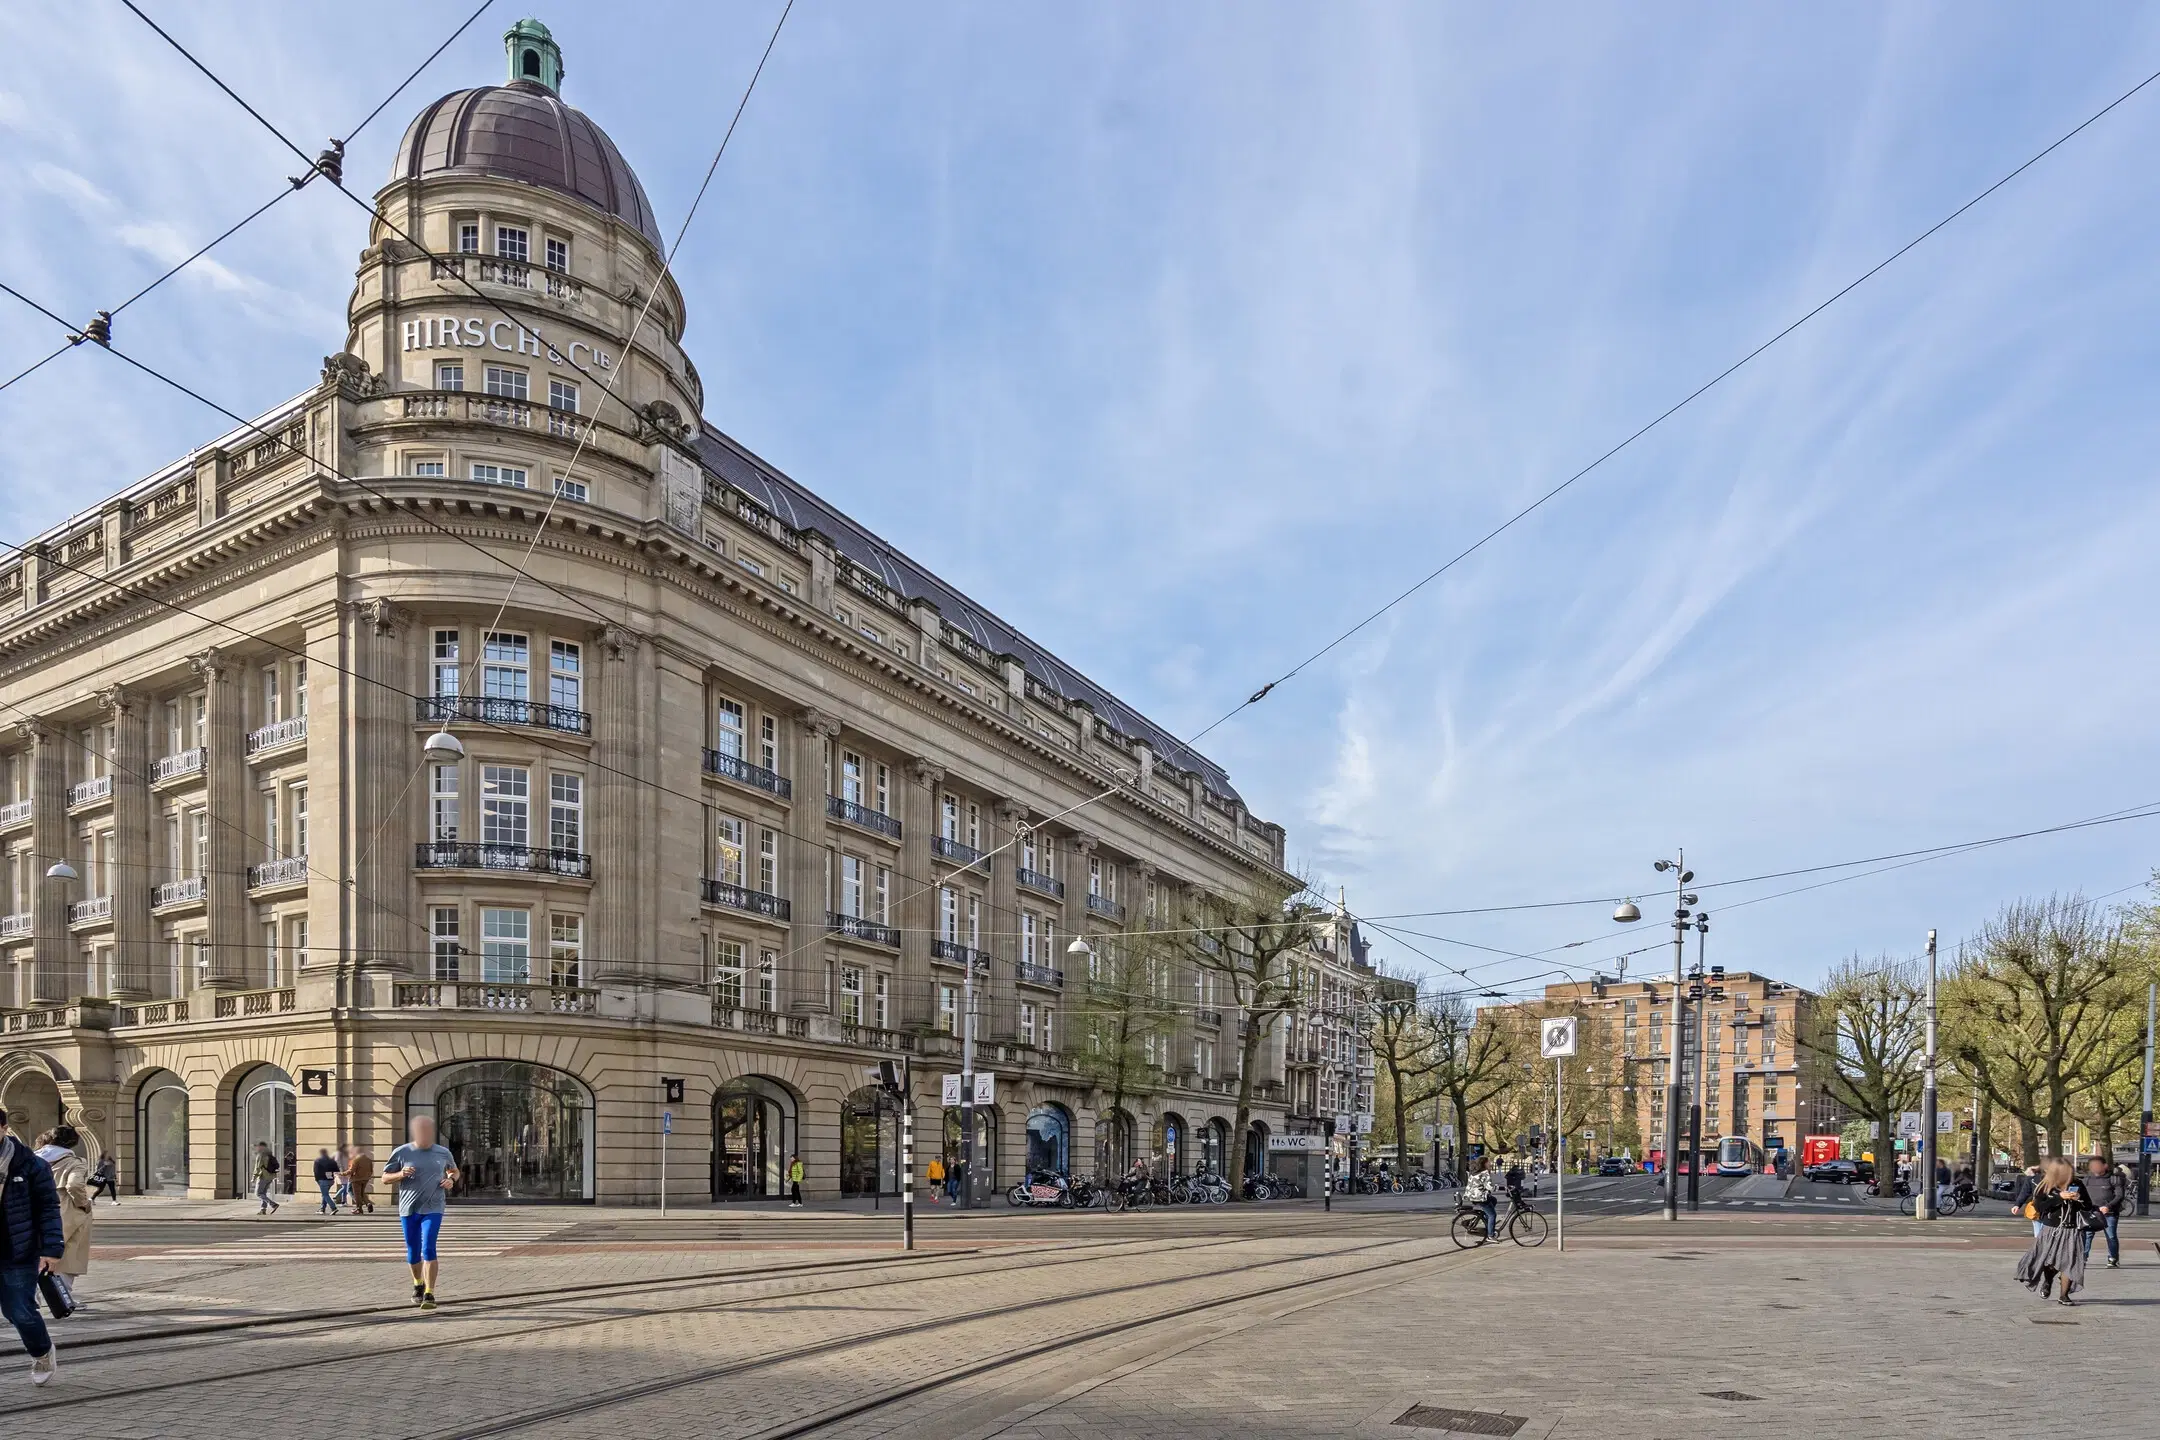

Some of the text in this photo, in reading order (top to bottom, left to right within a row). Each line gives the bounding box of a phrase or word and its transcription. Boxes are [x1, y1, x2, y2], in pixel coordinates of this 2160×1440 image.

[401, 316, 541, 357] HIRSCH
[547, 343, 563, 366] &
[1287, 1137, 1306, 1146] WC
